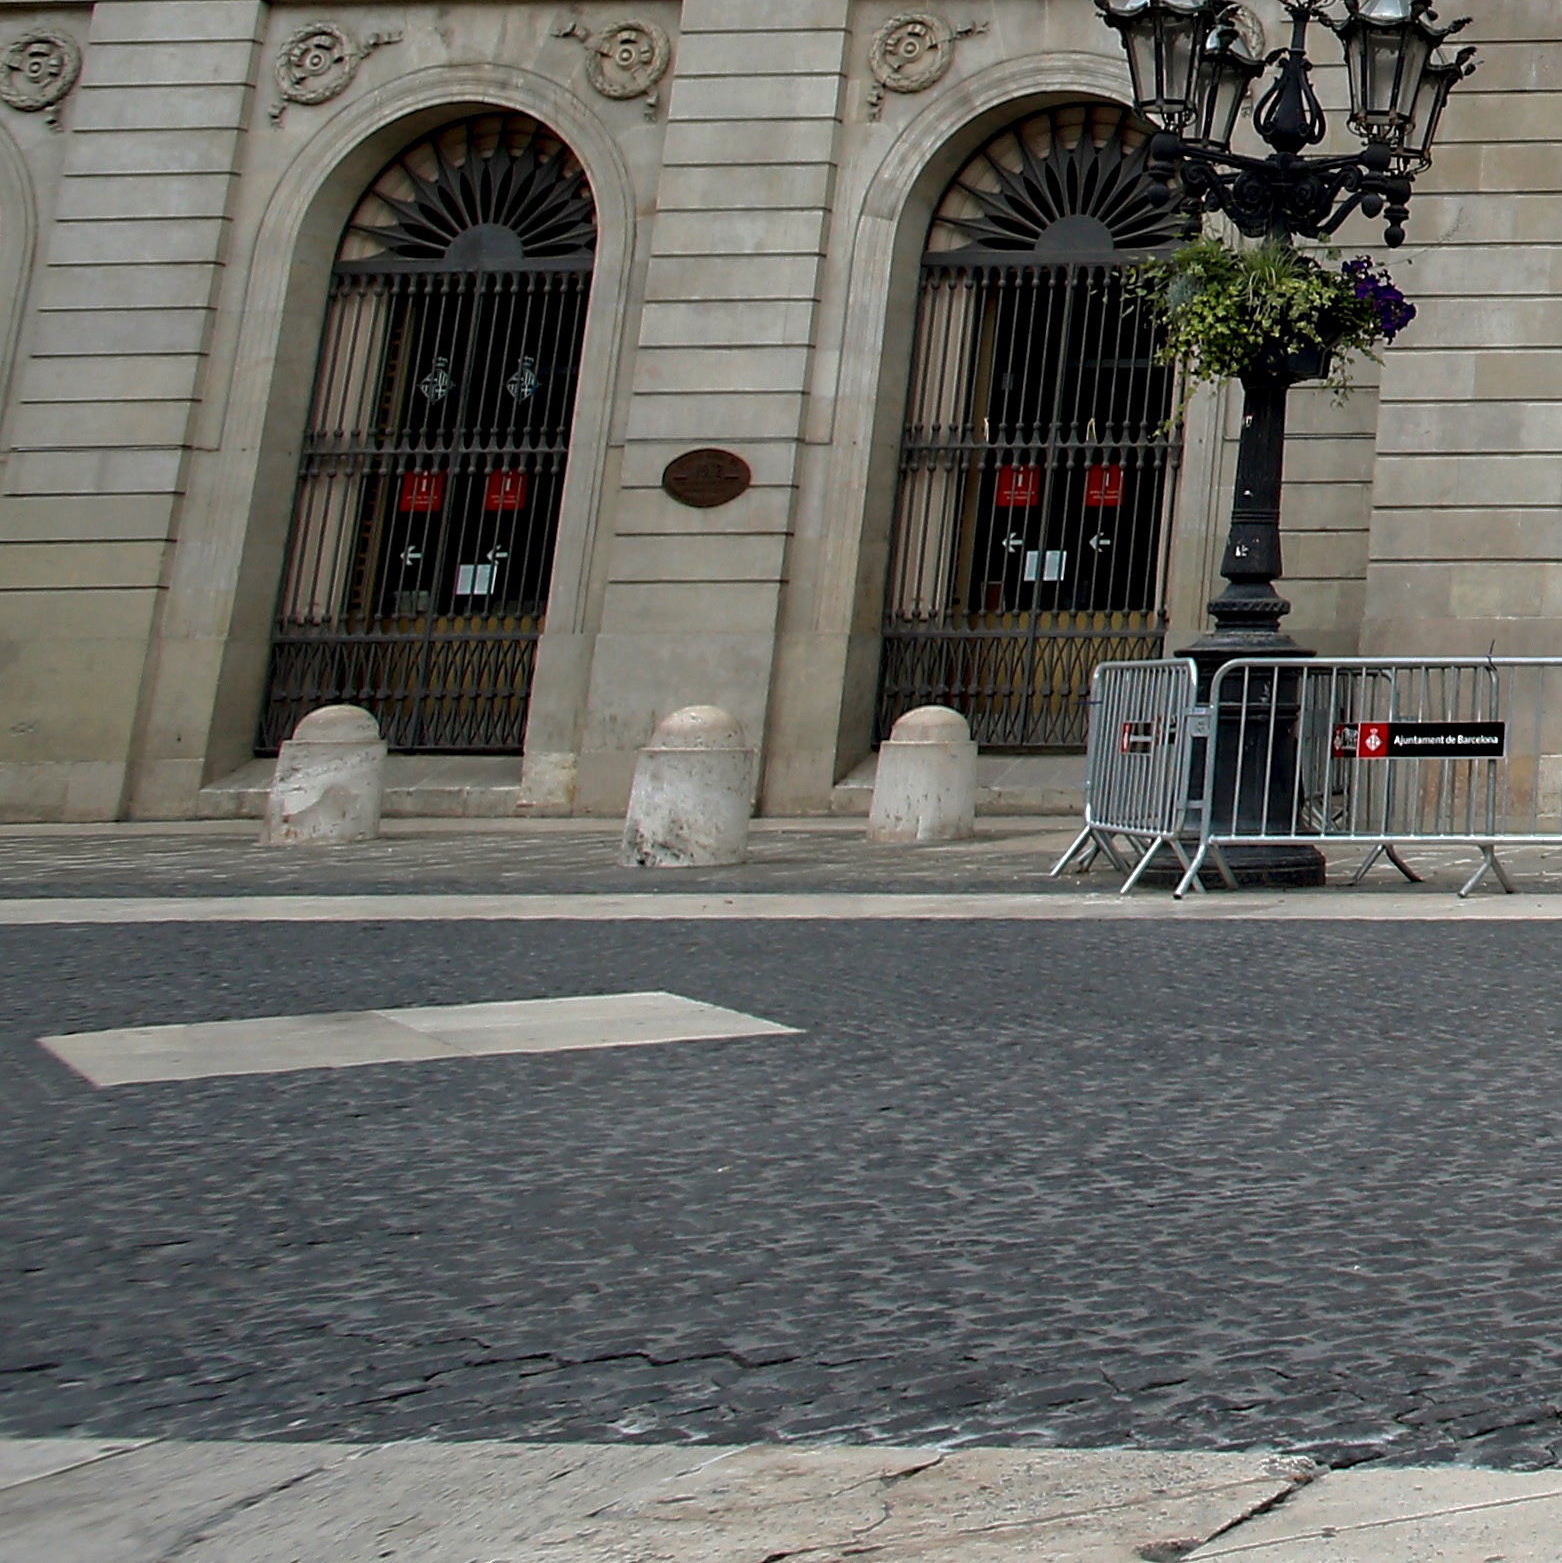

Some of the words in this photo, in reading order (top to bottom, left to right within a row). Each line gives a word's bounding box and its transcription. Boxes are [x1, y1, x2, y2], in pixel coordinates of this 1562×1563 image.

[1394, 735, 1444, 746] Ajuntament
[1445, 735, 1456, 744] de
[1458, 735, 1498, 744] Barcelona
